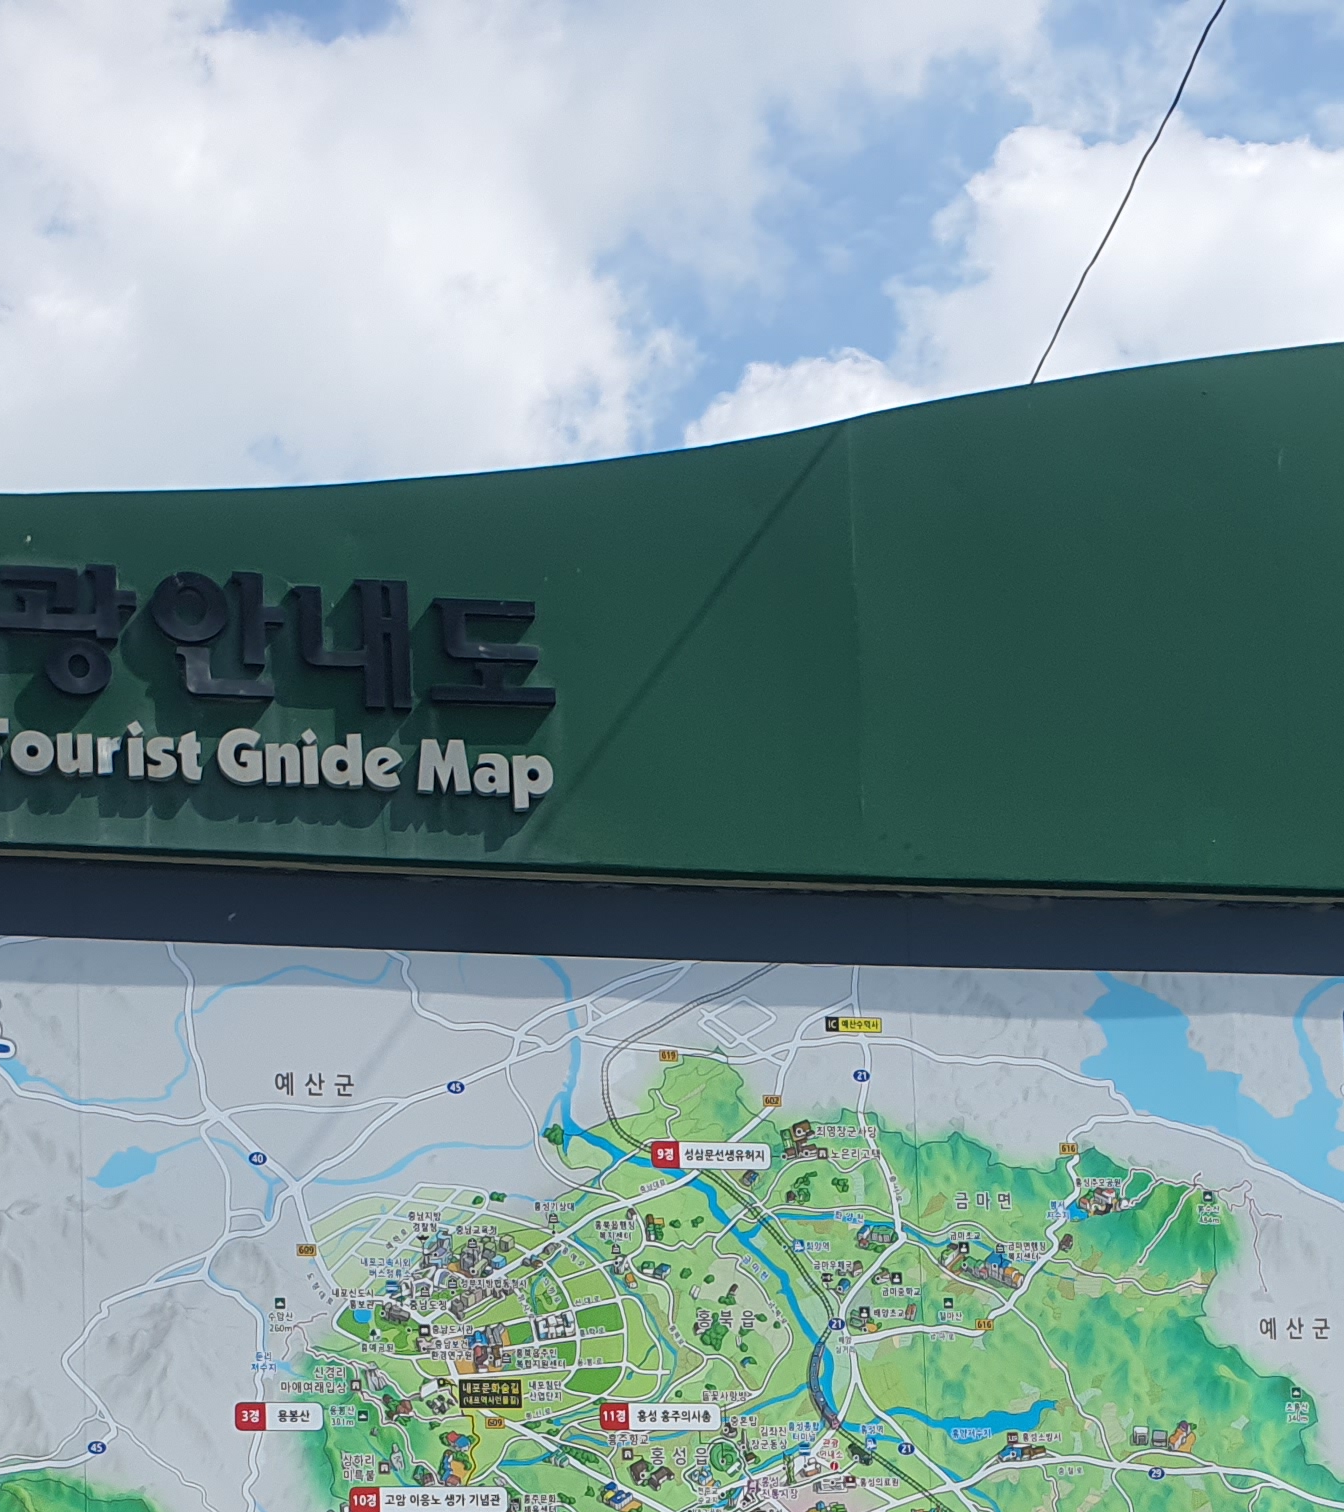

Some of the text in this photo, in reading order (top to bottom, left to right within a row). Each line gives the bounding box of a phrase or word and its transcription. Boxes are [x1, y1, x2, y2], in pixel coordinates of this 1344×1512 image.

[216, 725, 401, 790] Gnide
[417, 738, 554, 810] Map
[827, 1019, 837, 1030] IC
[856, 1070, 868, 1082] 21
[251, 1153, 264, 1165] 40
[657, 1145, 765, 1166] 9경 성삼문선생유허지
[315, 1367, 346, 1379] 신경리
[281, 1382, 346, 1394] 마애여래입상
[242, 1406, 310, 1424] 3경 용봉산
[603, 1406, 626, 1424] 11경
[637, 1407, 657, 1424] 홍성
[90, 1442, 105, 1453] 45
[352, 1490, 500, 1508] 10경 고암 이응노 생가 기념관
